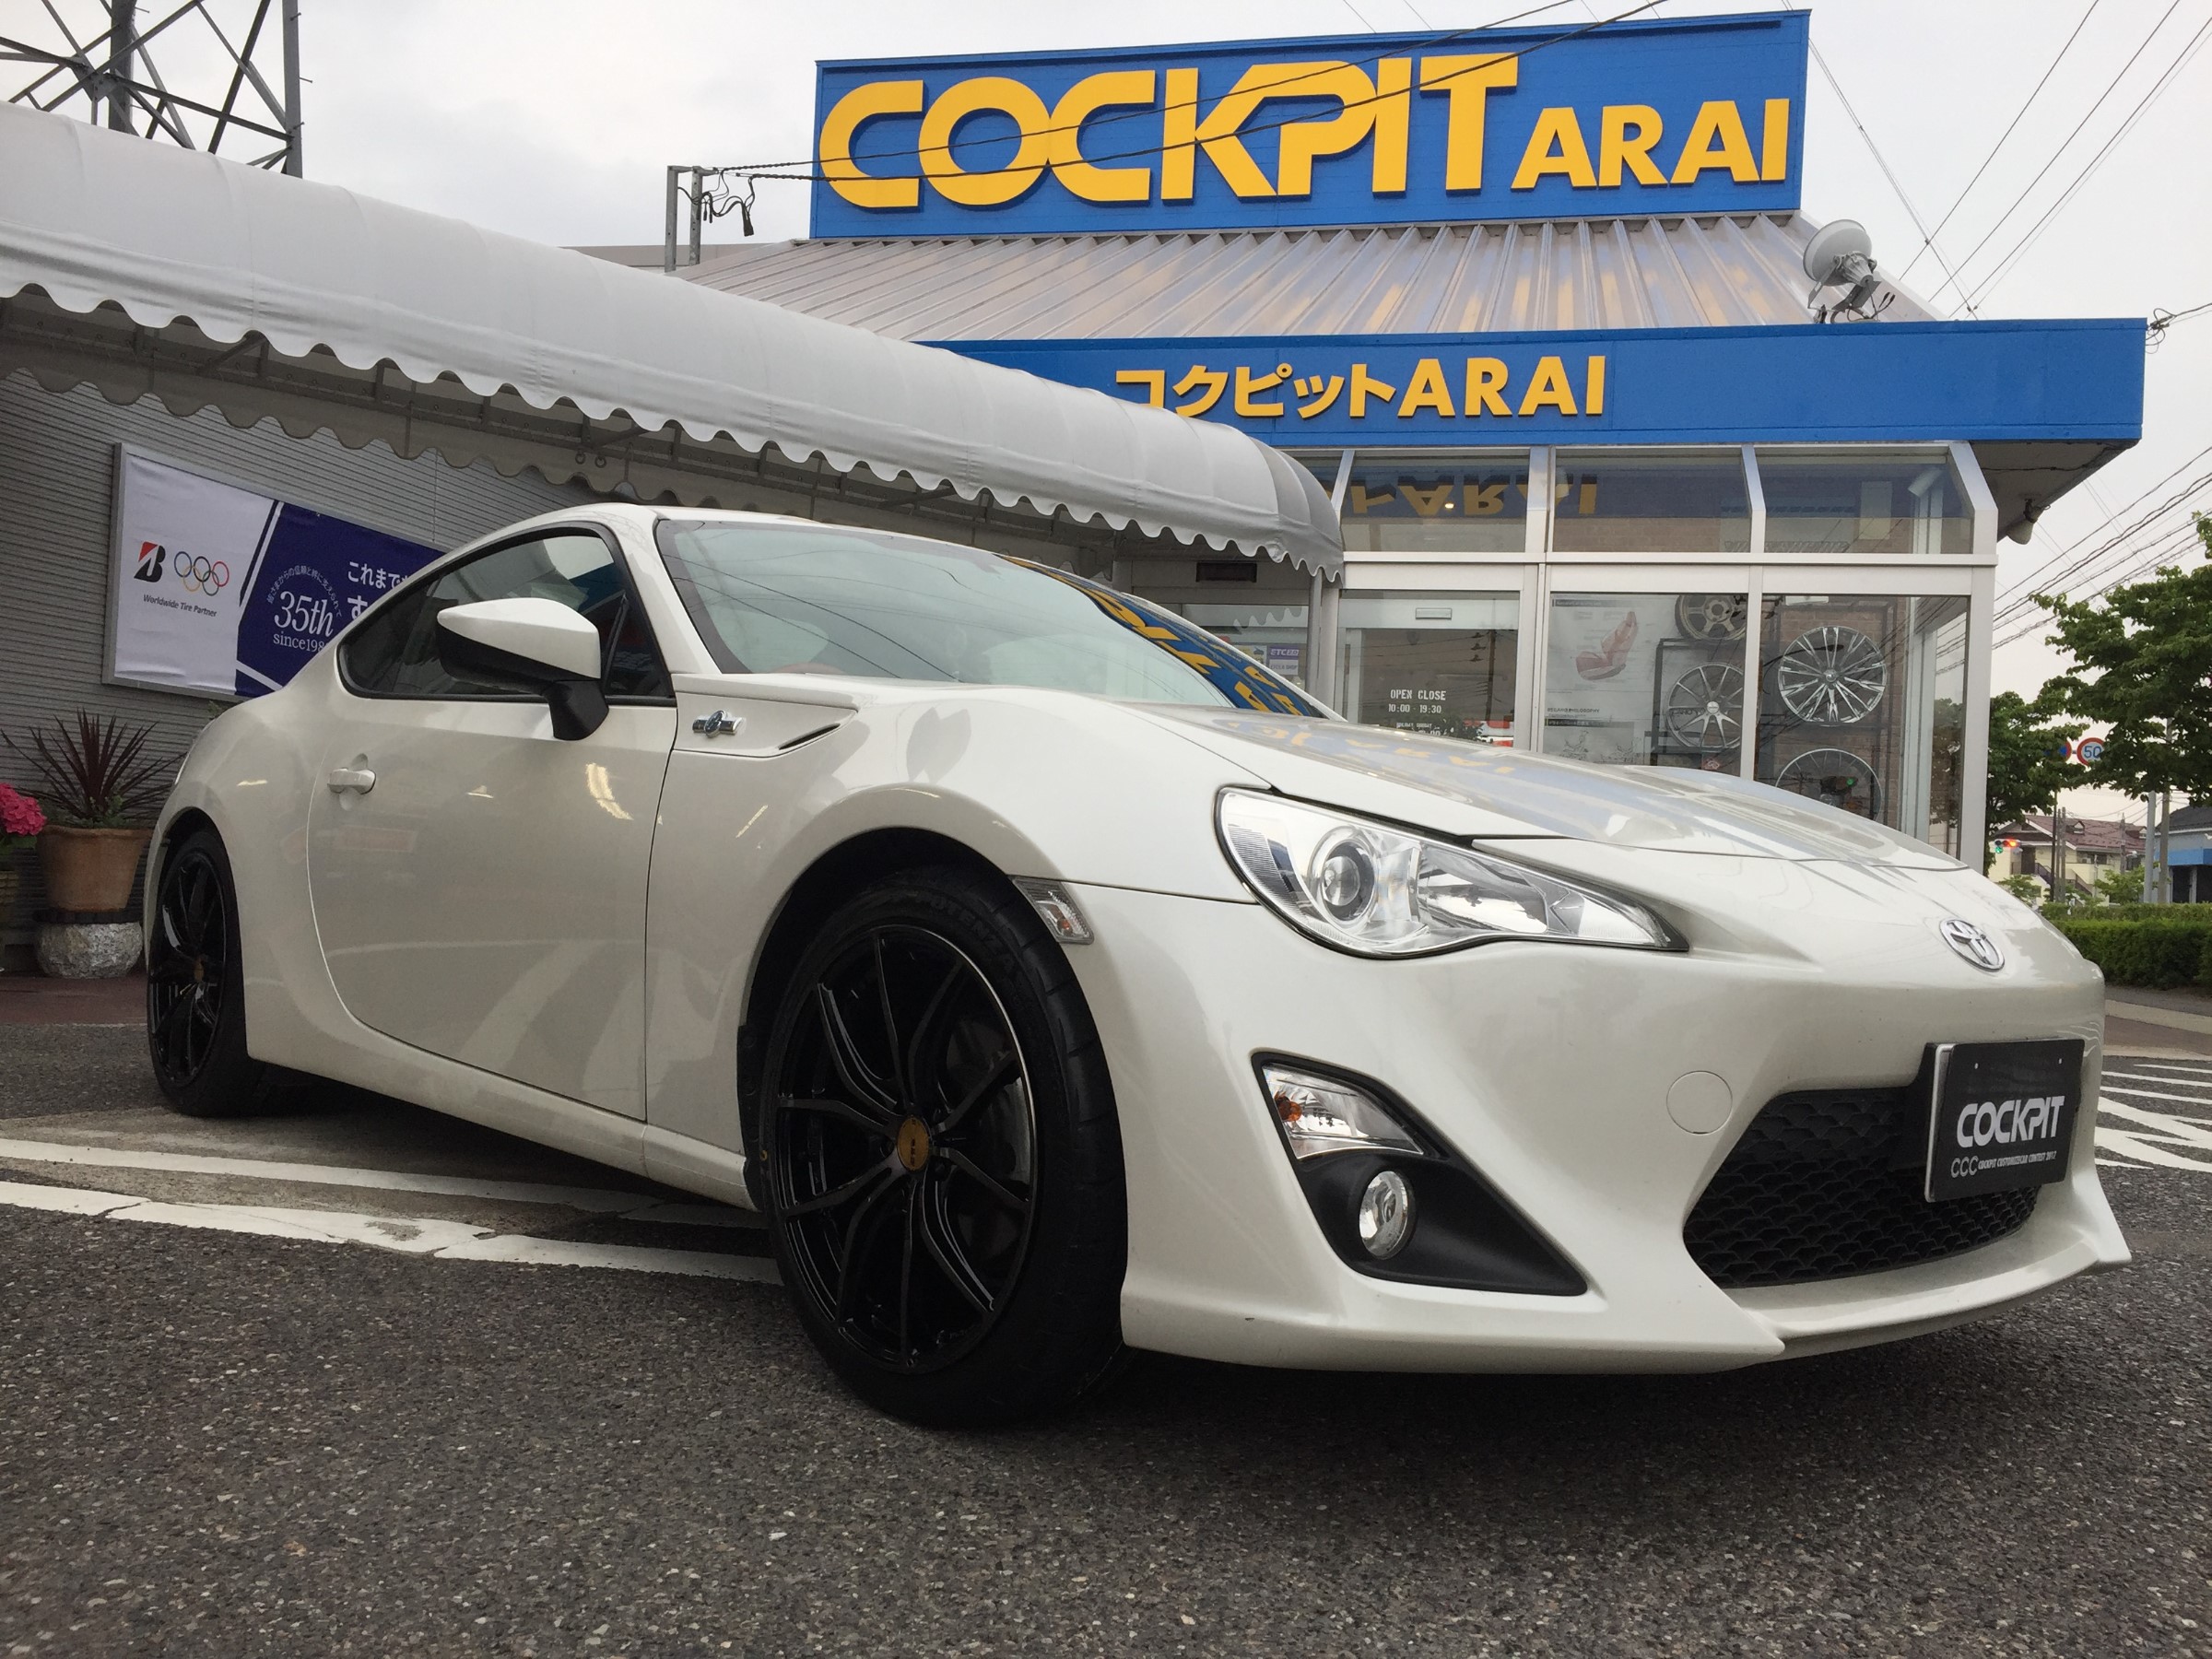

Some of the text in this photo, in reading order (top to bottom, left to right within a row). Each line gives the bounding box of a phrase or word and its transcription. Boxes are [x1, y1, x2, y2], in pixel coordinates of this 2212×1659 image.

[819, 53, 1790, 207] COCKPIT ARAI
[348, 561, 408, 590] これまで
[143, 594, 218, 618] Worldwide Tire Partner
[274, 591, 334, 638] 35th
[273, 630, 325, 653] since198
[1390, 689, 1447, 700] OPEN CLOSE
[1388, 703, 1410, 712] 10:00
[1419, 704, 1441, 713] 19:30
[2084, 745, 2102, 759] 50
[1957, 1096, 2065, 1147] COCKPIT
[1950, 1156, 1979, 1178] CCC
